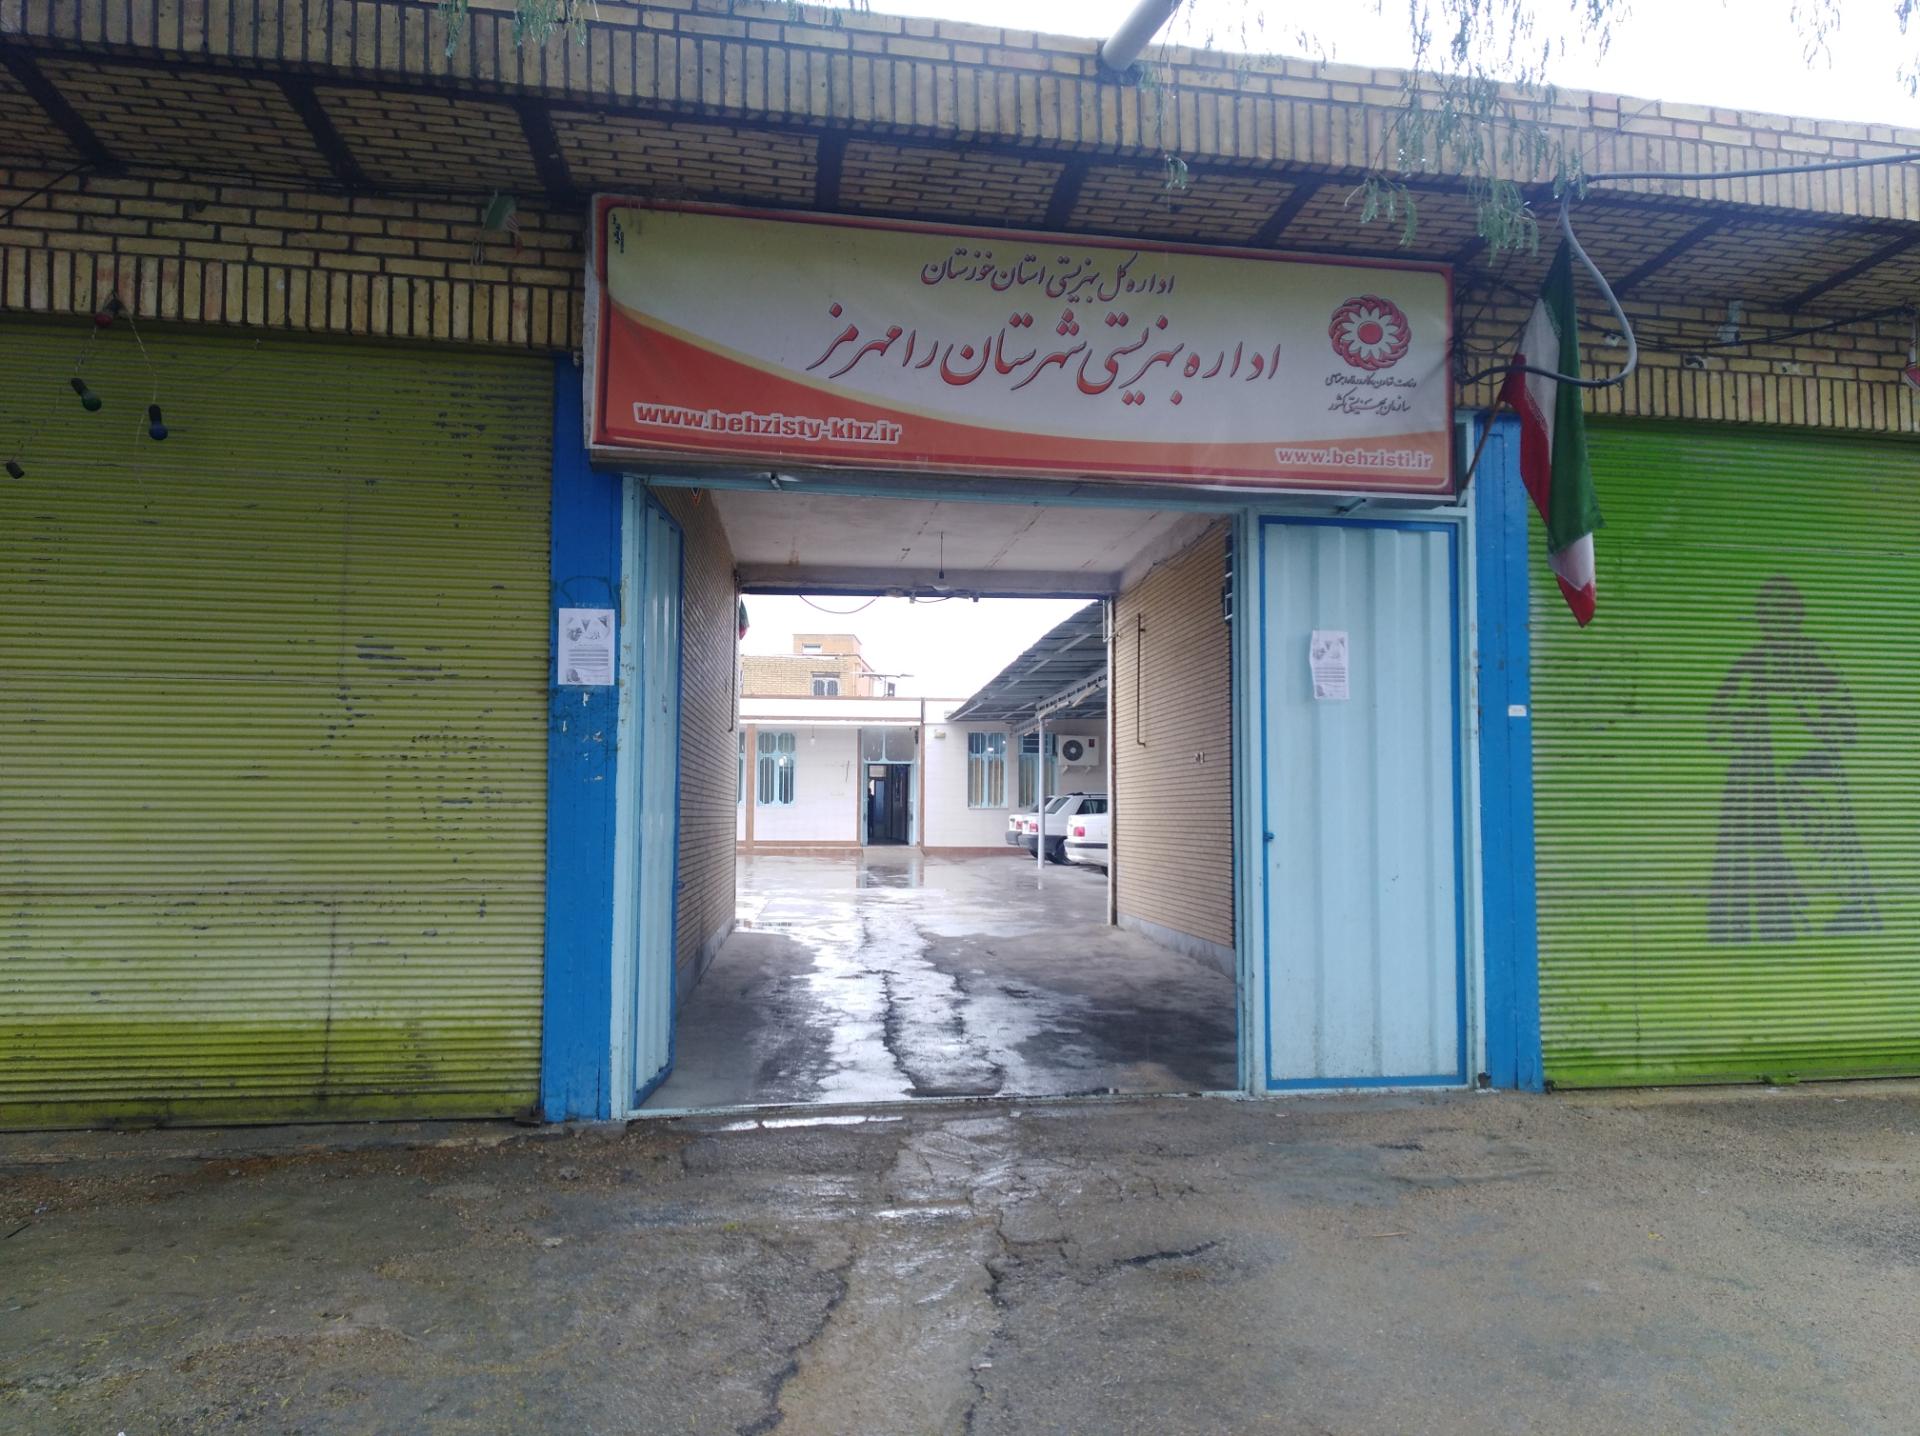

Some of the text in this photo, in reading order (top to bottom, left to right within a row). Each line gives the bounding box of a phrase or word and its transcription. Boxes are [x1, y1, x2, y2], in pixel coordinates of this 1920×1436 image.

[921, 248, 1175, 303] اداره کل بهزیستی استان خوزستان
[806, 302, 1281, 406] اداره بهزیستی شهرستان رامهرمز
[634, 403, 900, 442] www.behzisty-khz.ir
[1379, 395, 1411, 415] سازمان
[1276, 448, 1433, 469] www.behzisti.ir
